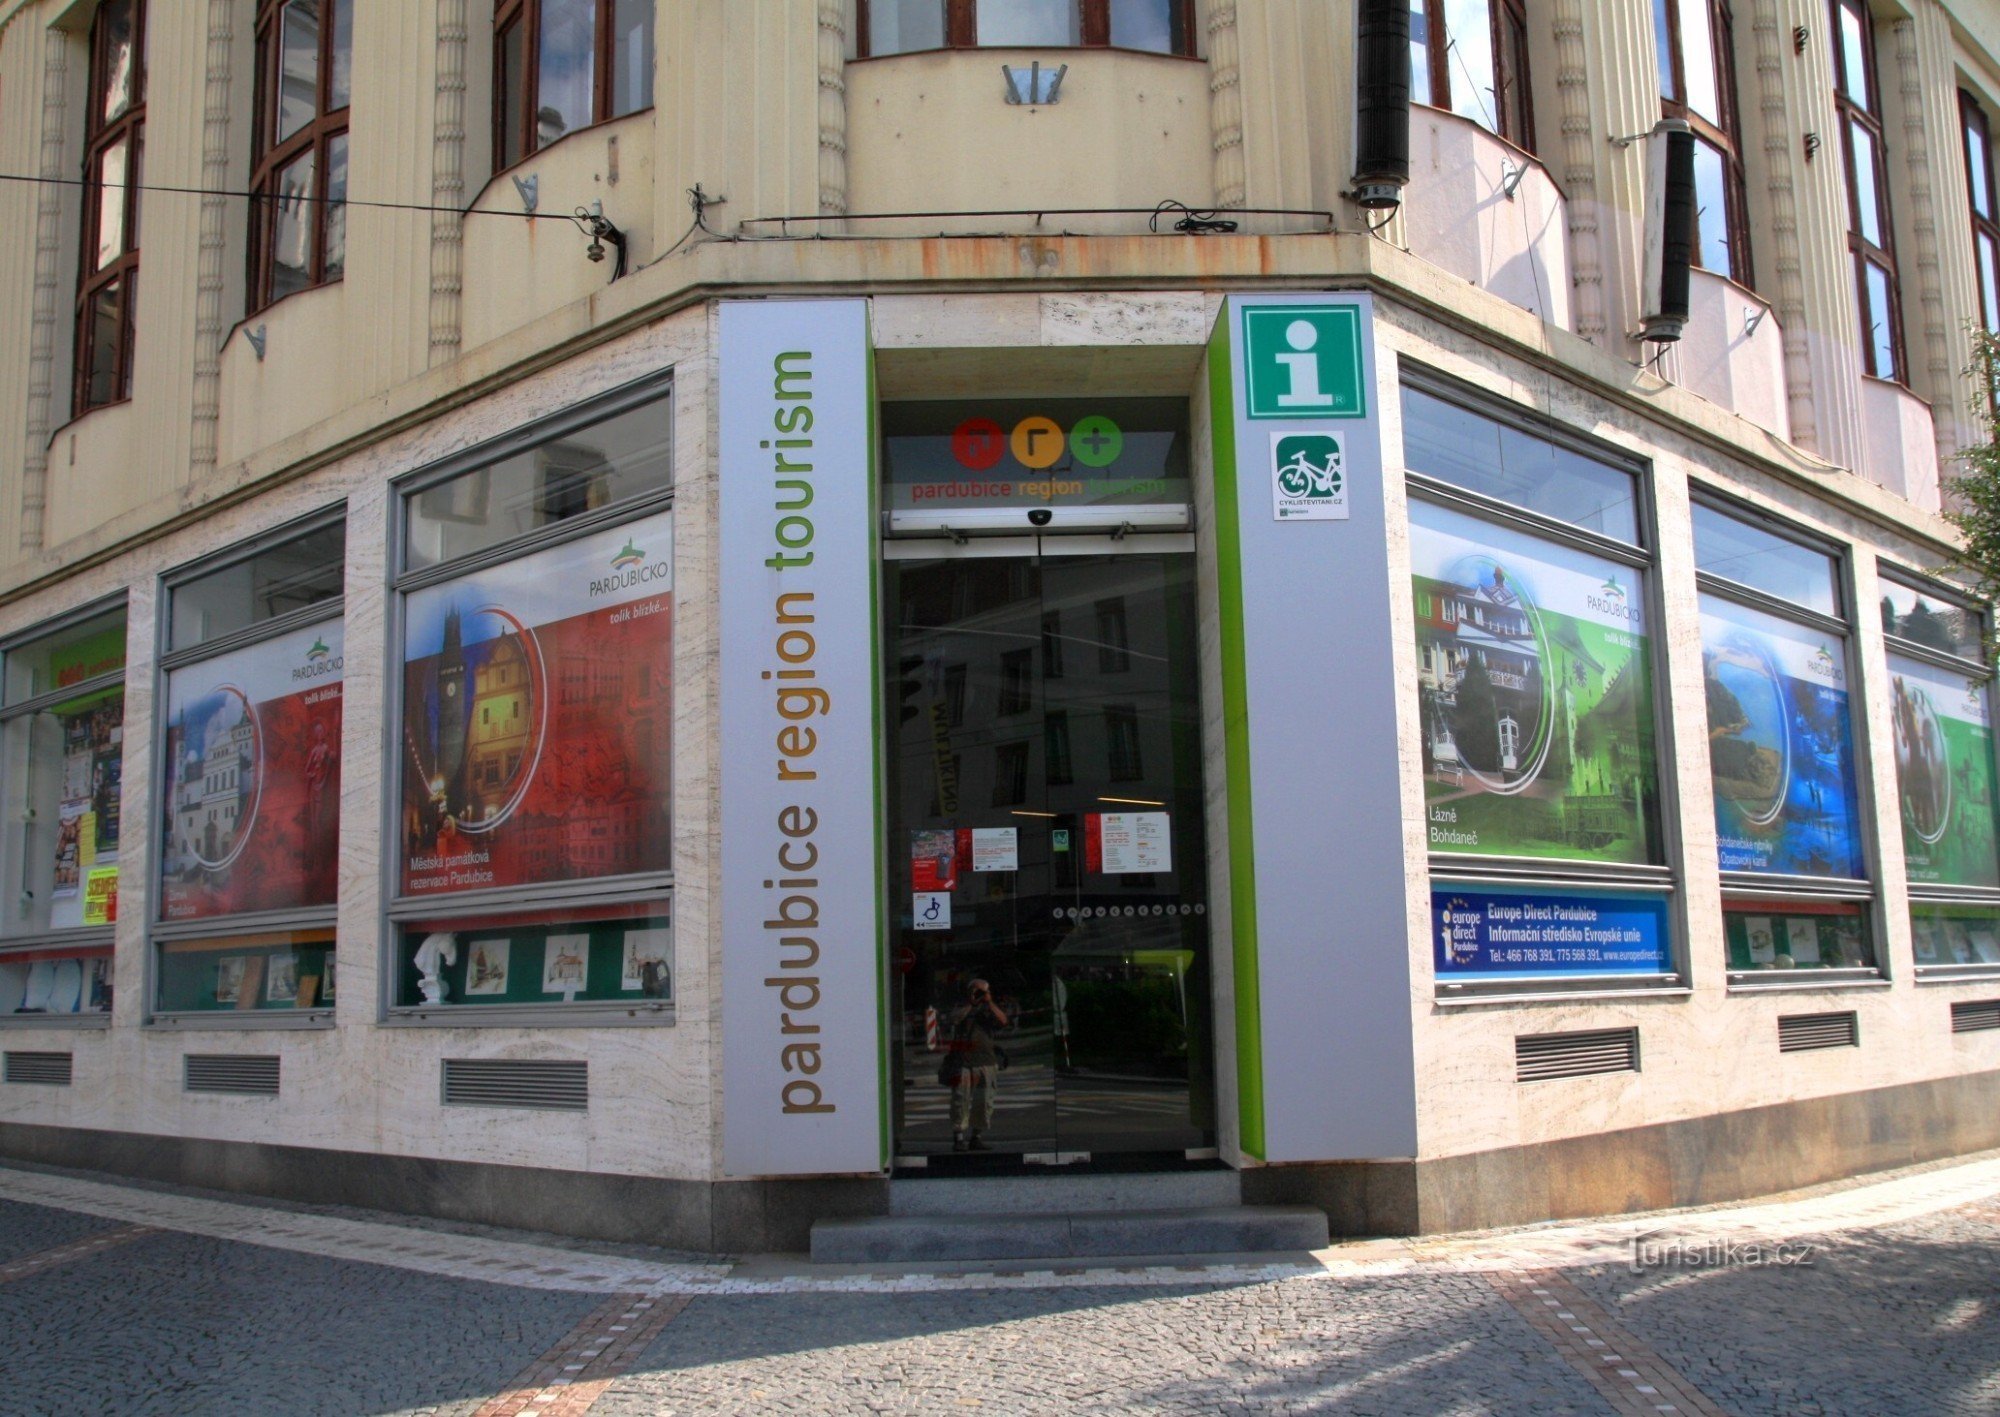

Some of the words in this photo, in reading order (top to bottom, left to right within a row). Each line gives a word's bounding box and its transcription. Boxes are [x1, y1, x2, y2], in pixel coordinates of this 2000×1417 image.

[760, 351, 814, 571] tourism
[912, 479, 1012, 502] pardubice
[1018, 475, 1083, 501] region
[589, 562, 668, 597] PARDUBICKO
[609, 608, 631, 624] tolik
[1587, 595, 1641, 622] PARDUBICKO
[292, 656, 344, 681] PARDUBICKO
[761, 592, 830, 781] region
[1429, 805, 1457, 822] Lázně
[1431, 827, 1478, 845] Bohdaneč
[410, 854, 443, 871] Městská
[446, 849, 489, 871] památková
[410, 876, 448, 889] rezervace
[450, 870, 493, 885] Pardubice
[1452, 911, 1480, 928] europe
[1488, 902, 1522, 923] Europe
[1524, 904, 1552, 920] Direct
[1553, 905, 1597, 921] Pardubice
[1453, 924, 1477, 940] direct
[1489, 924, 1540, 942] Informační
[1543, 925, 1582, 941] středisko
[1584, 926, 1621, 945] Evropské
[1624, 928, 1641, 942] unie
[1453, 942, 1478, 951] Pardubice
[1489, 949, 1505, 962] Tel.:
[1506, 949, 1522, 961] 466
[1524, 949, 1537, 962] 768
[1557, 949, 1571, 961] 775
[1572, 949, 1585, 961] 568
[1603, 949, 1664, 963] www.europedirect.cz
[763, 805, 836, 1114] pardubice
